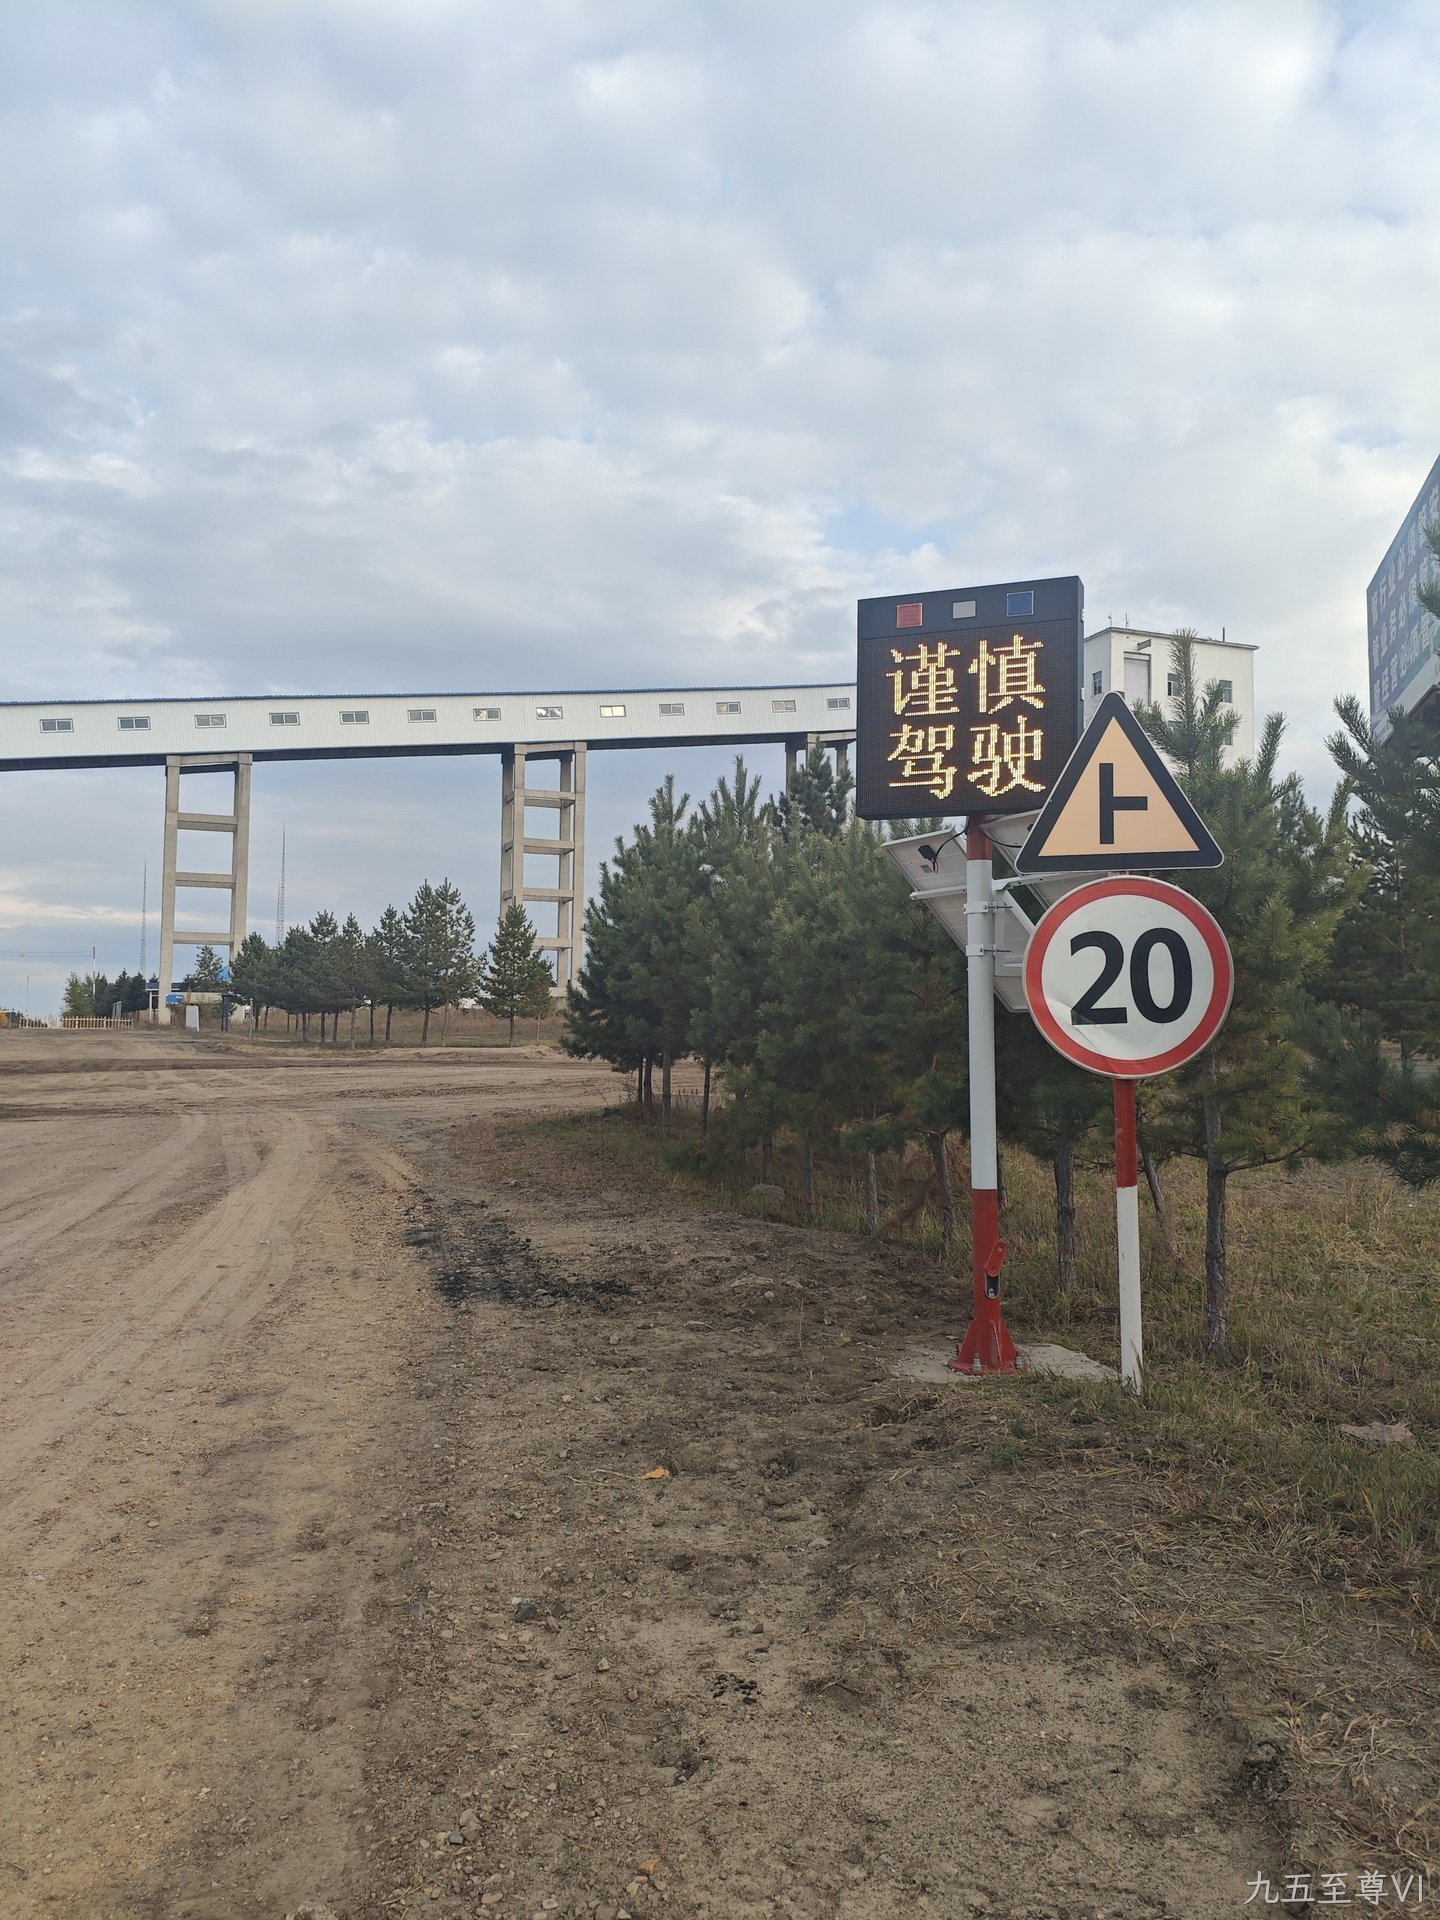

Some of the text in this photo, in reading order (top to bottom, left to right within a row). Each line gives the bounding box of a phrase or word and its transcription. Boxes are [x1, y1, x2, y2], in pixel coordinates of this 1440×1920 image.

[886, 634, 1046, 717] 谨慎
[887, 715, 1046, 799] 驾驶
[1070, 927, 1193, 1026] 20
